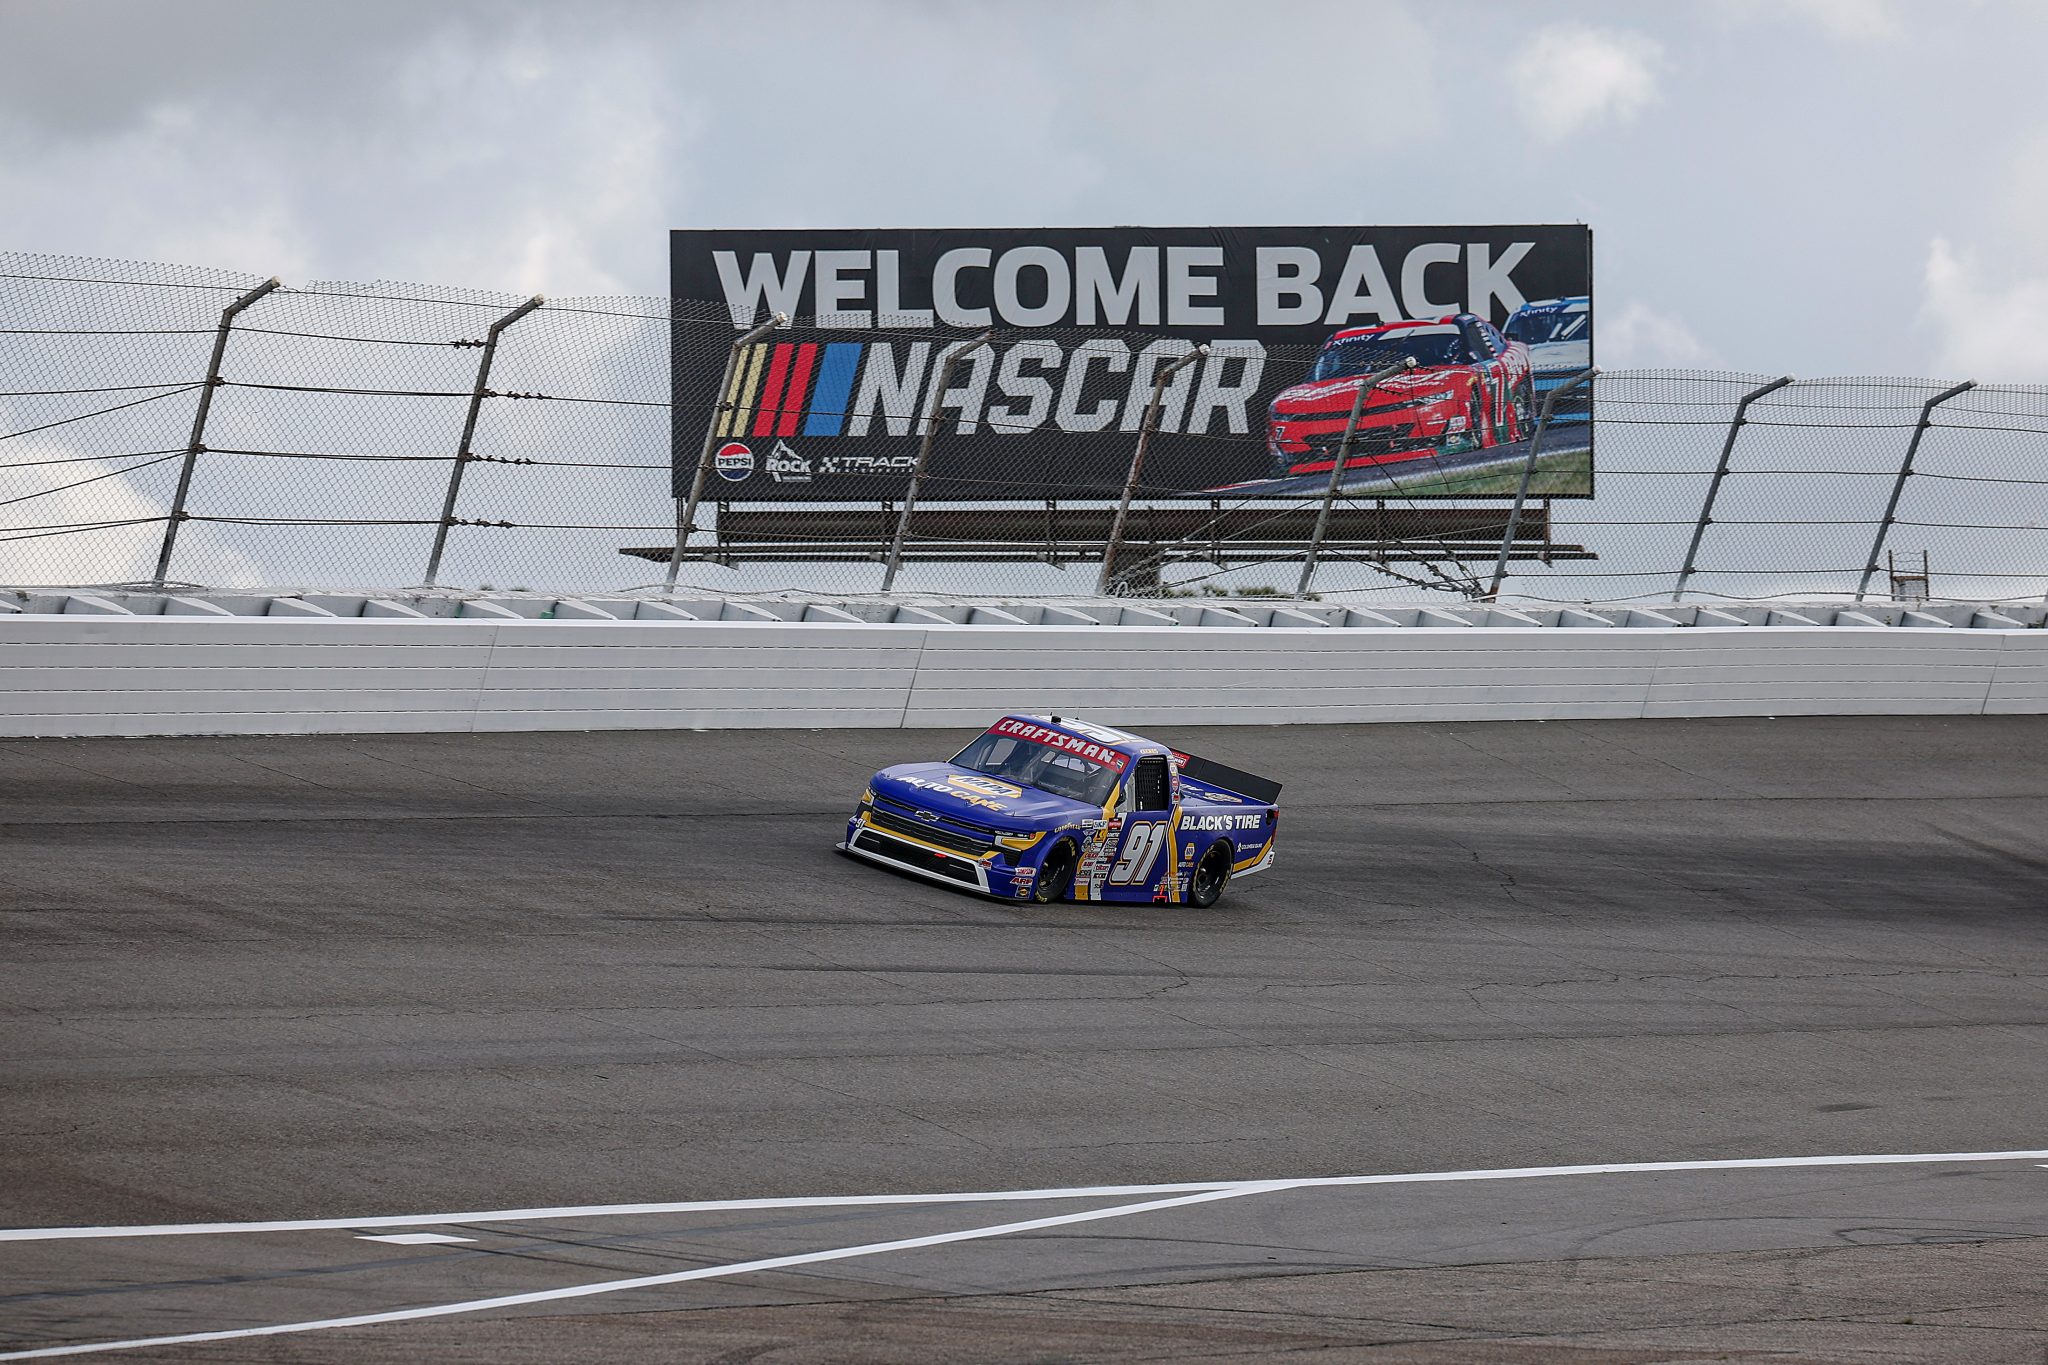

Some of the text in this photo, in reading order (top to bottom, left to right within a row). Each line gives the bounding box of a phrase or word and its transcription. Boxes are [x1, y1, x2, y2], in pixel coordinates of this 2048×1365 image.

[712, 242, 1536, 330] WELCOME BACK
[1519, 306, 1558, 318] xfinity
[1332, 333, 1375, 346] xfinity
[847, 339, 1267, 436] NASCAR
[718, 457, 752, 467] PEPSI
[766, 456, 812, 474] ROCK
[841, 456, 919, 467] TRACK
[998, 720, 1115, 764] CRAFTSMAN
[896, 776, 952, 793] AUTO
[855, 818, 867, 829] 91
[1180, 815, 1261, 831] BLACK'S TIRE
[1109, 821, 1168, 885] 91
[1010, 877, 1033, 886] ARP
